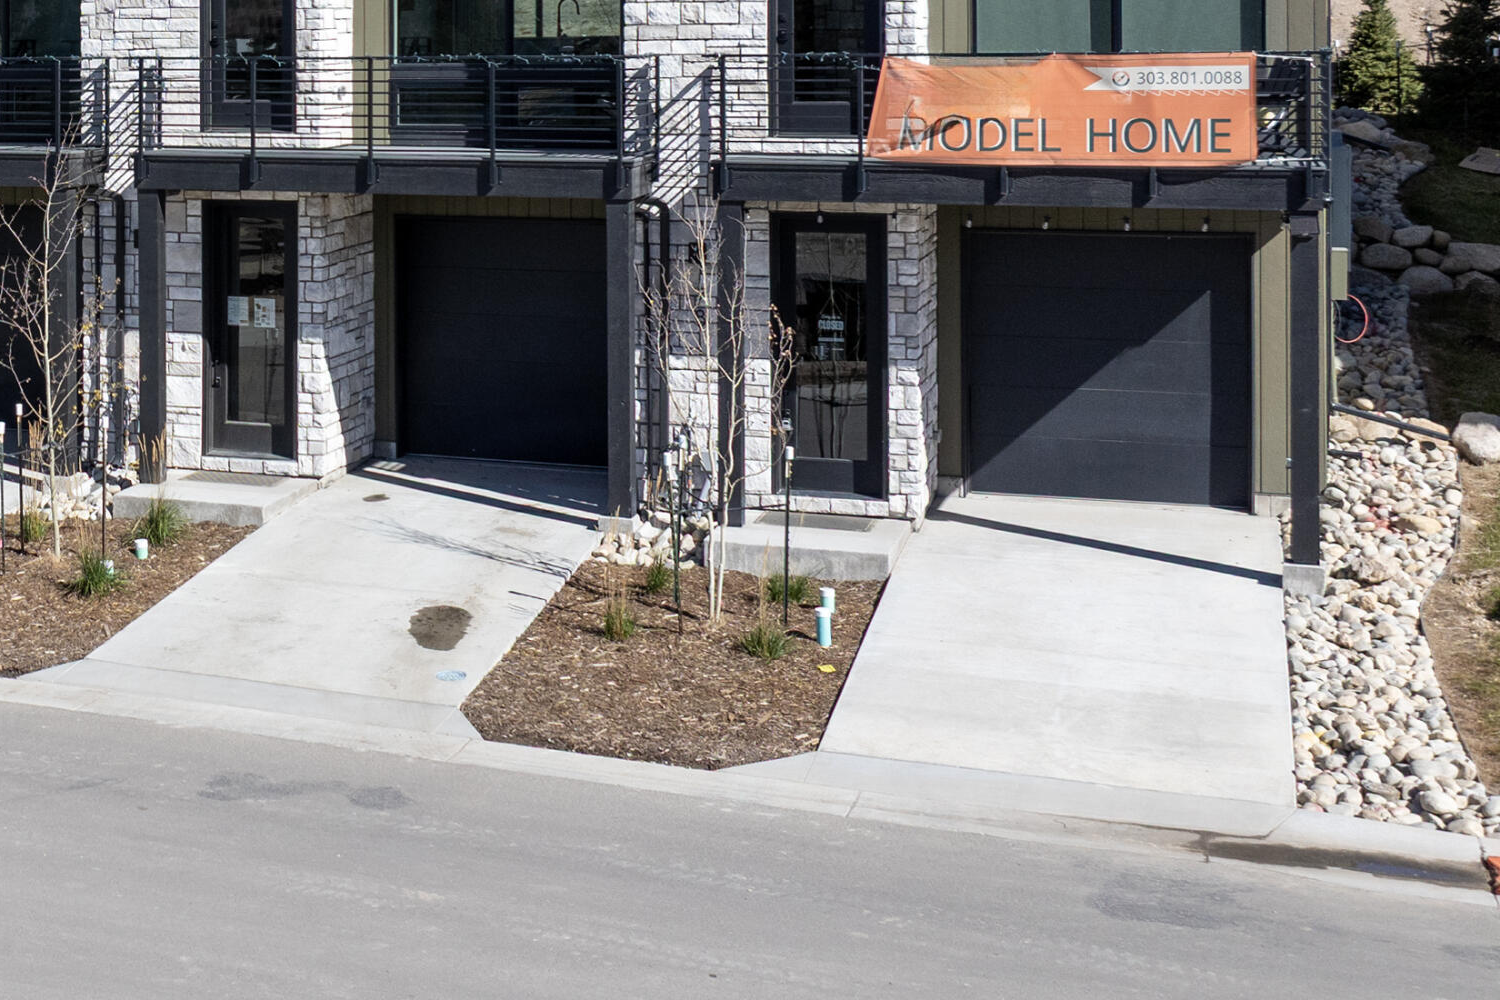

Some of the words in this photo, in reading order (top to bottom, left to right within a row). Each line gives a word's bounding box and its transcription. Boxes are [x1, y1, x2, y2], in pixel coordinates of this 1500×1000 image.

[1137, 71, 1243, 85] 303.801.0088
[898, 115, 1061, 152] MODEL
[1086, 117, 1232, 153] HOME
